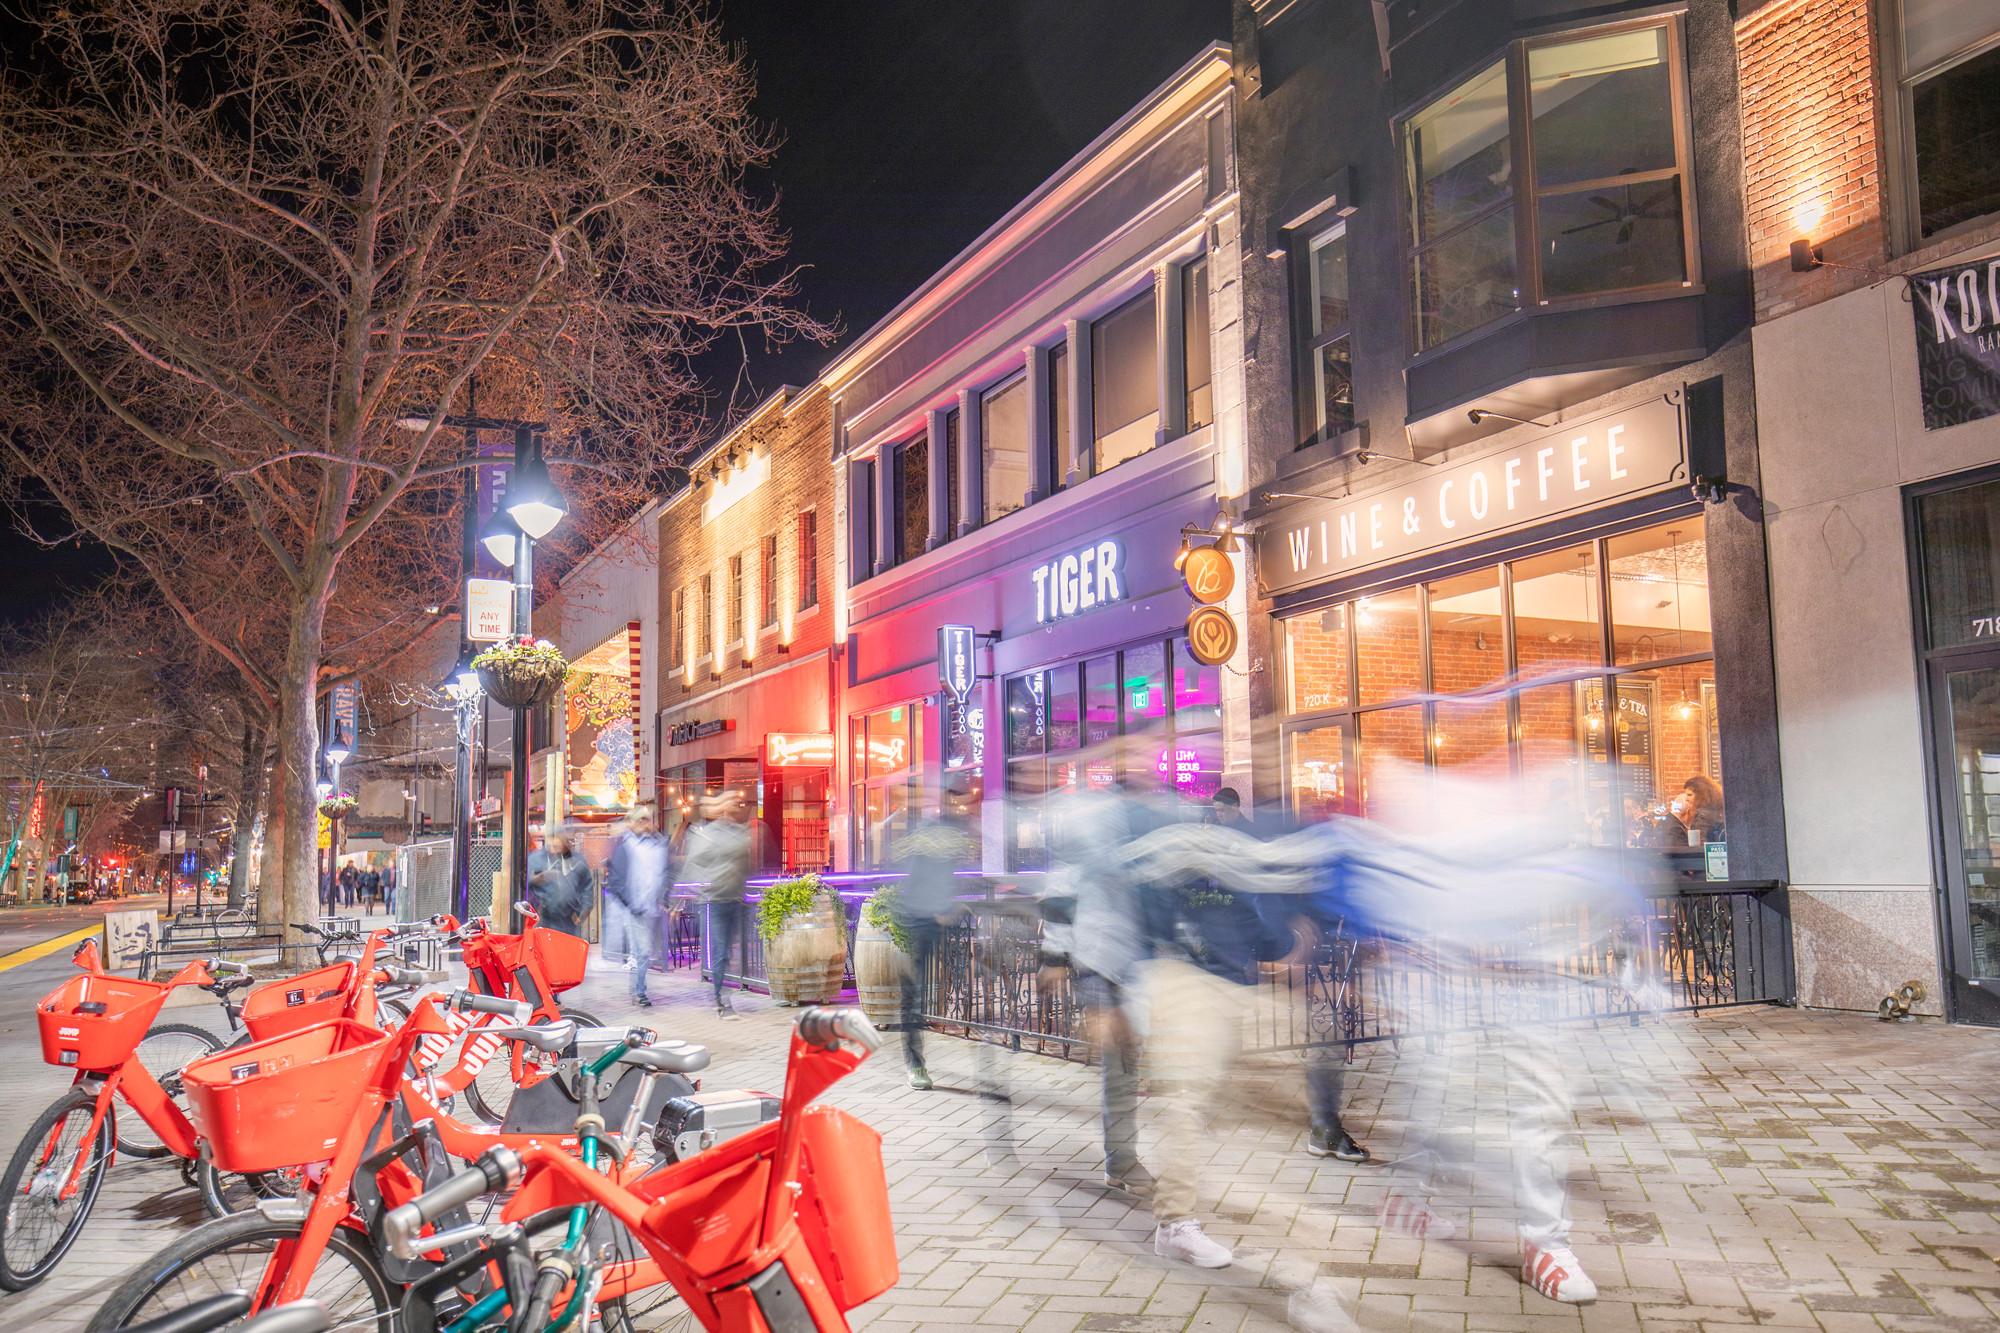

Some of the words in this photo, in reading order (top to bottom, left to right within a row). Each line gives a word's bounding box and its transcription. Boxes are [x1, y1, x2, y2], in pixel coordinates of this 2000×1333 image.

[1288, 503, 1385, 573] WINE
[1402, 496, 1421, 536] &
[1438, 424, 1628, 529] COFFEE
[1032, 541, 1120, 623] TIGER
[479, 623, 502, 634] TIME
[480, 611, 500, 621] ANY
[953, 630, 967, 691] TIGER
[335, 680, 355, 728] RAVE
[1304, 695, 1321, 709] 720
[1322, 692, 1330, 704] K
[1628, 699, 1648, 717] TEA
[419, 1009, 478, 1067] JUM
[463, 1012, 518, 1076] JUM
